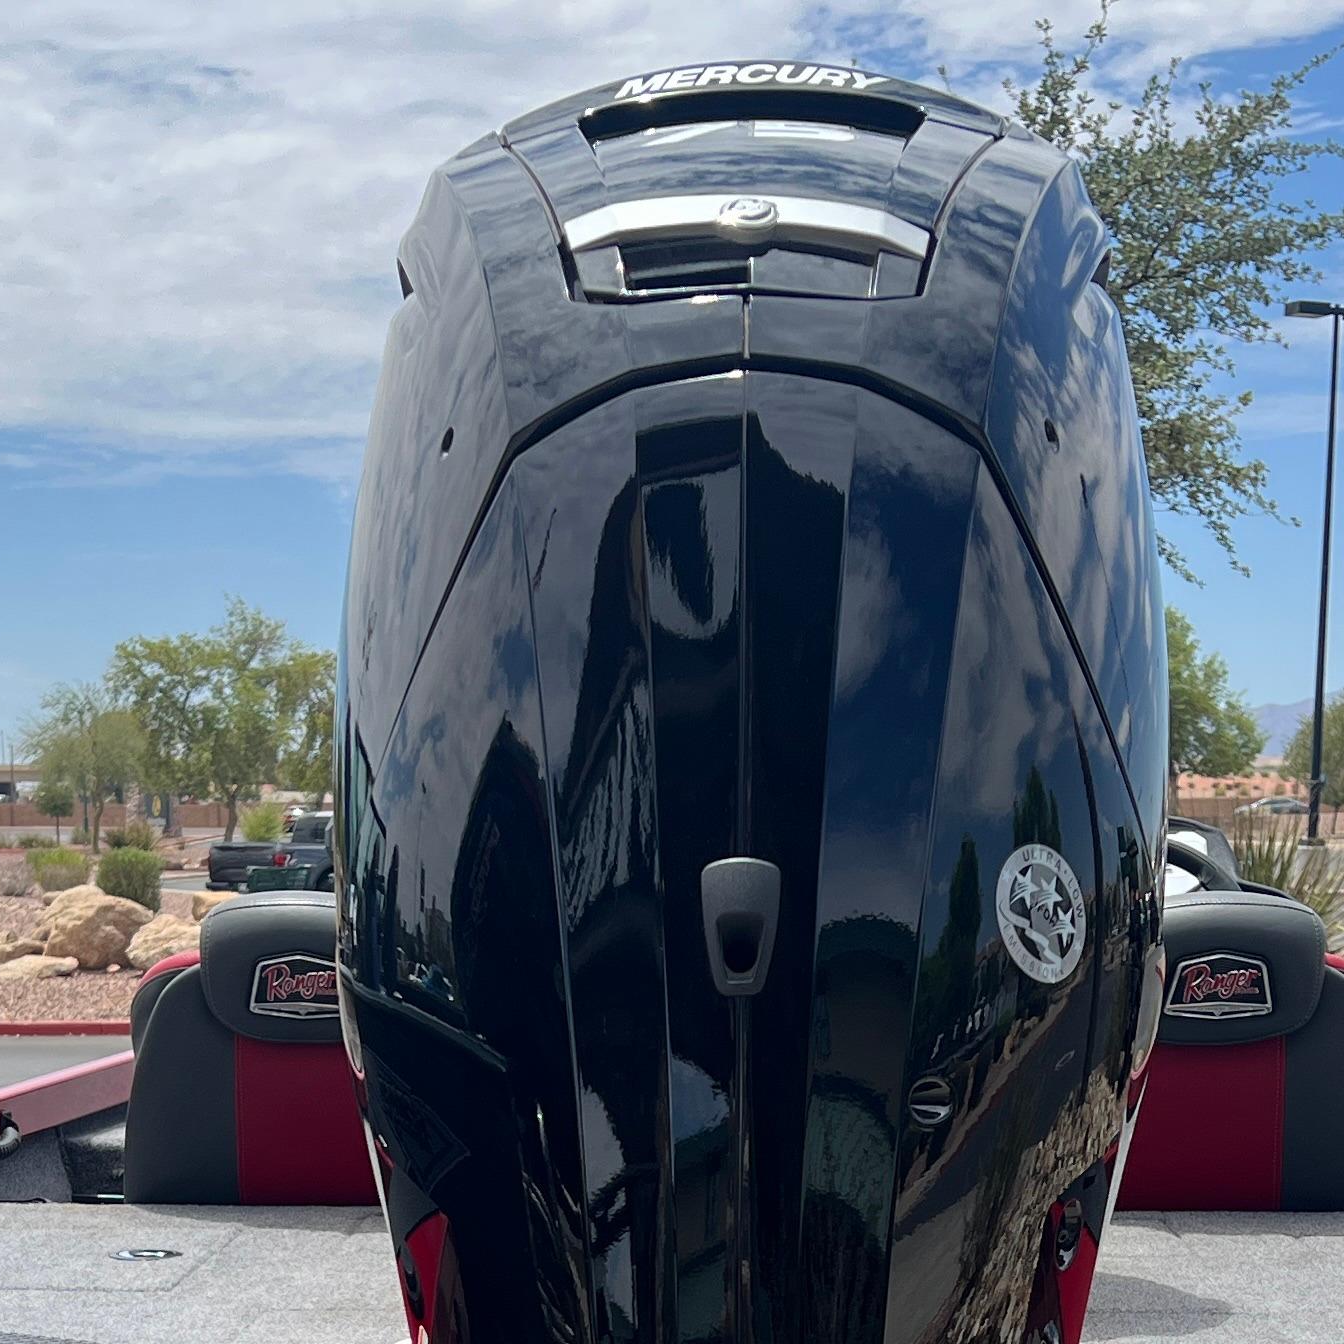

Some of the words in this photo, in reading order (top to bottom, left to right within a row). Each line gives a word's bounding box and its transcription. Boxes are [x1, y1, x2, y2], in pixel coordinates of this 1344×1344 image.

[614, 61, 892, 100] MERCURY
[1022, 849, 1062, 873] ULTRA
[1066, 880, 1084, 918] LOW
[1182, 964, 1259, 1002] Ranger
